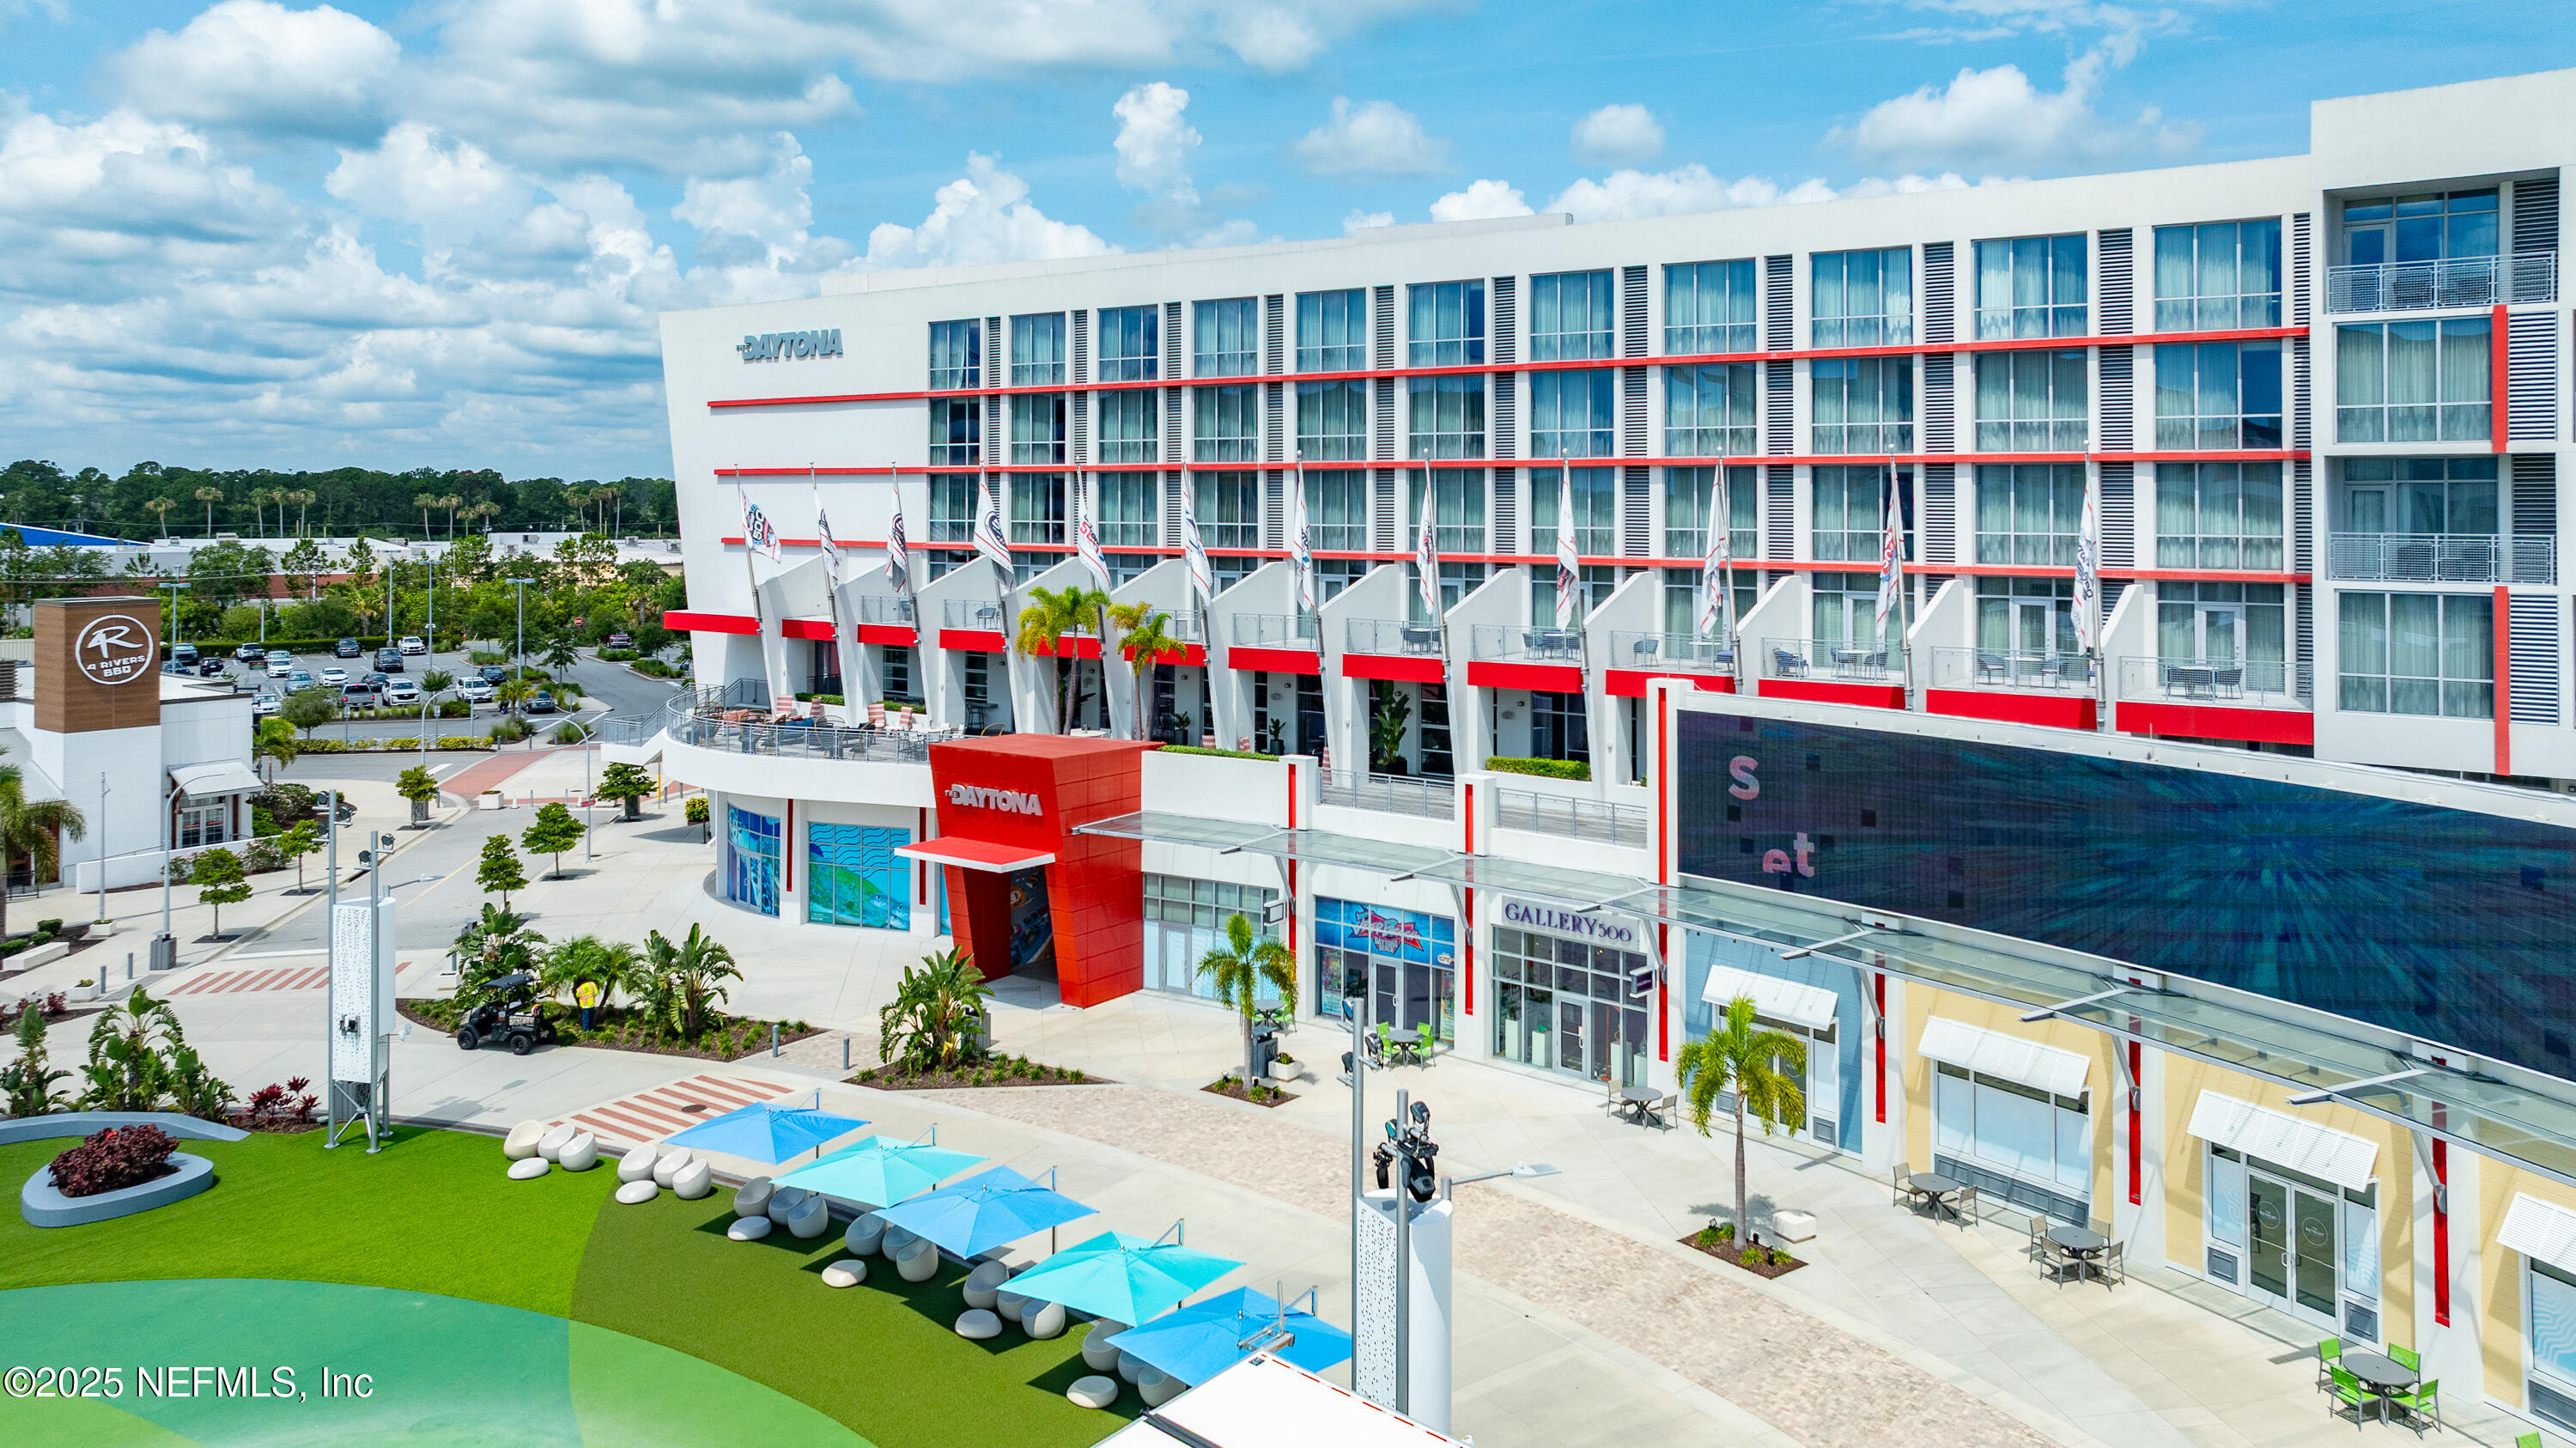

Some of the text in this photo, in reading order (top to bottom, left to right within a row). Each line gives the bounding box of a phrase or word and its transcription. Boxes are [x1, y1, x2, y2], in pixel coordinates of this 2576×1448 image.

[743, 328, 843, 361] DAYTONA
[100, 655, 145, 669] RIVERS
[103, 665, 131, 678] BBQ
[945, 783, 1043, 816] THE DAYTONA
